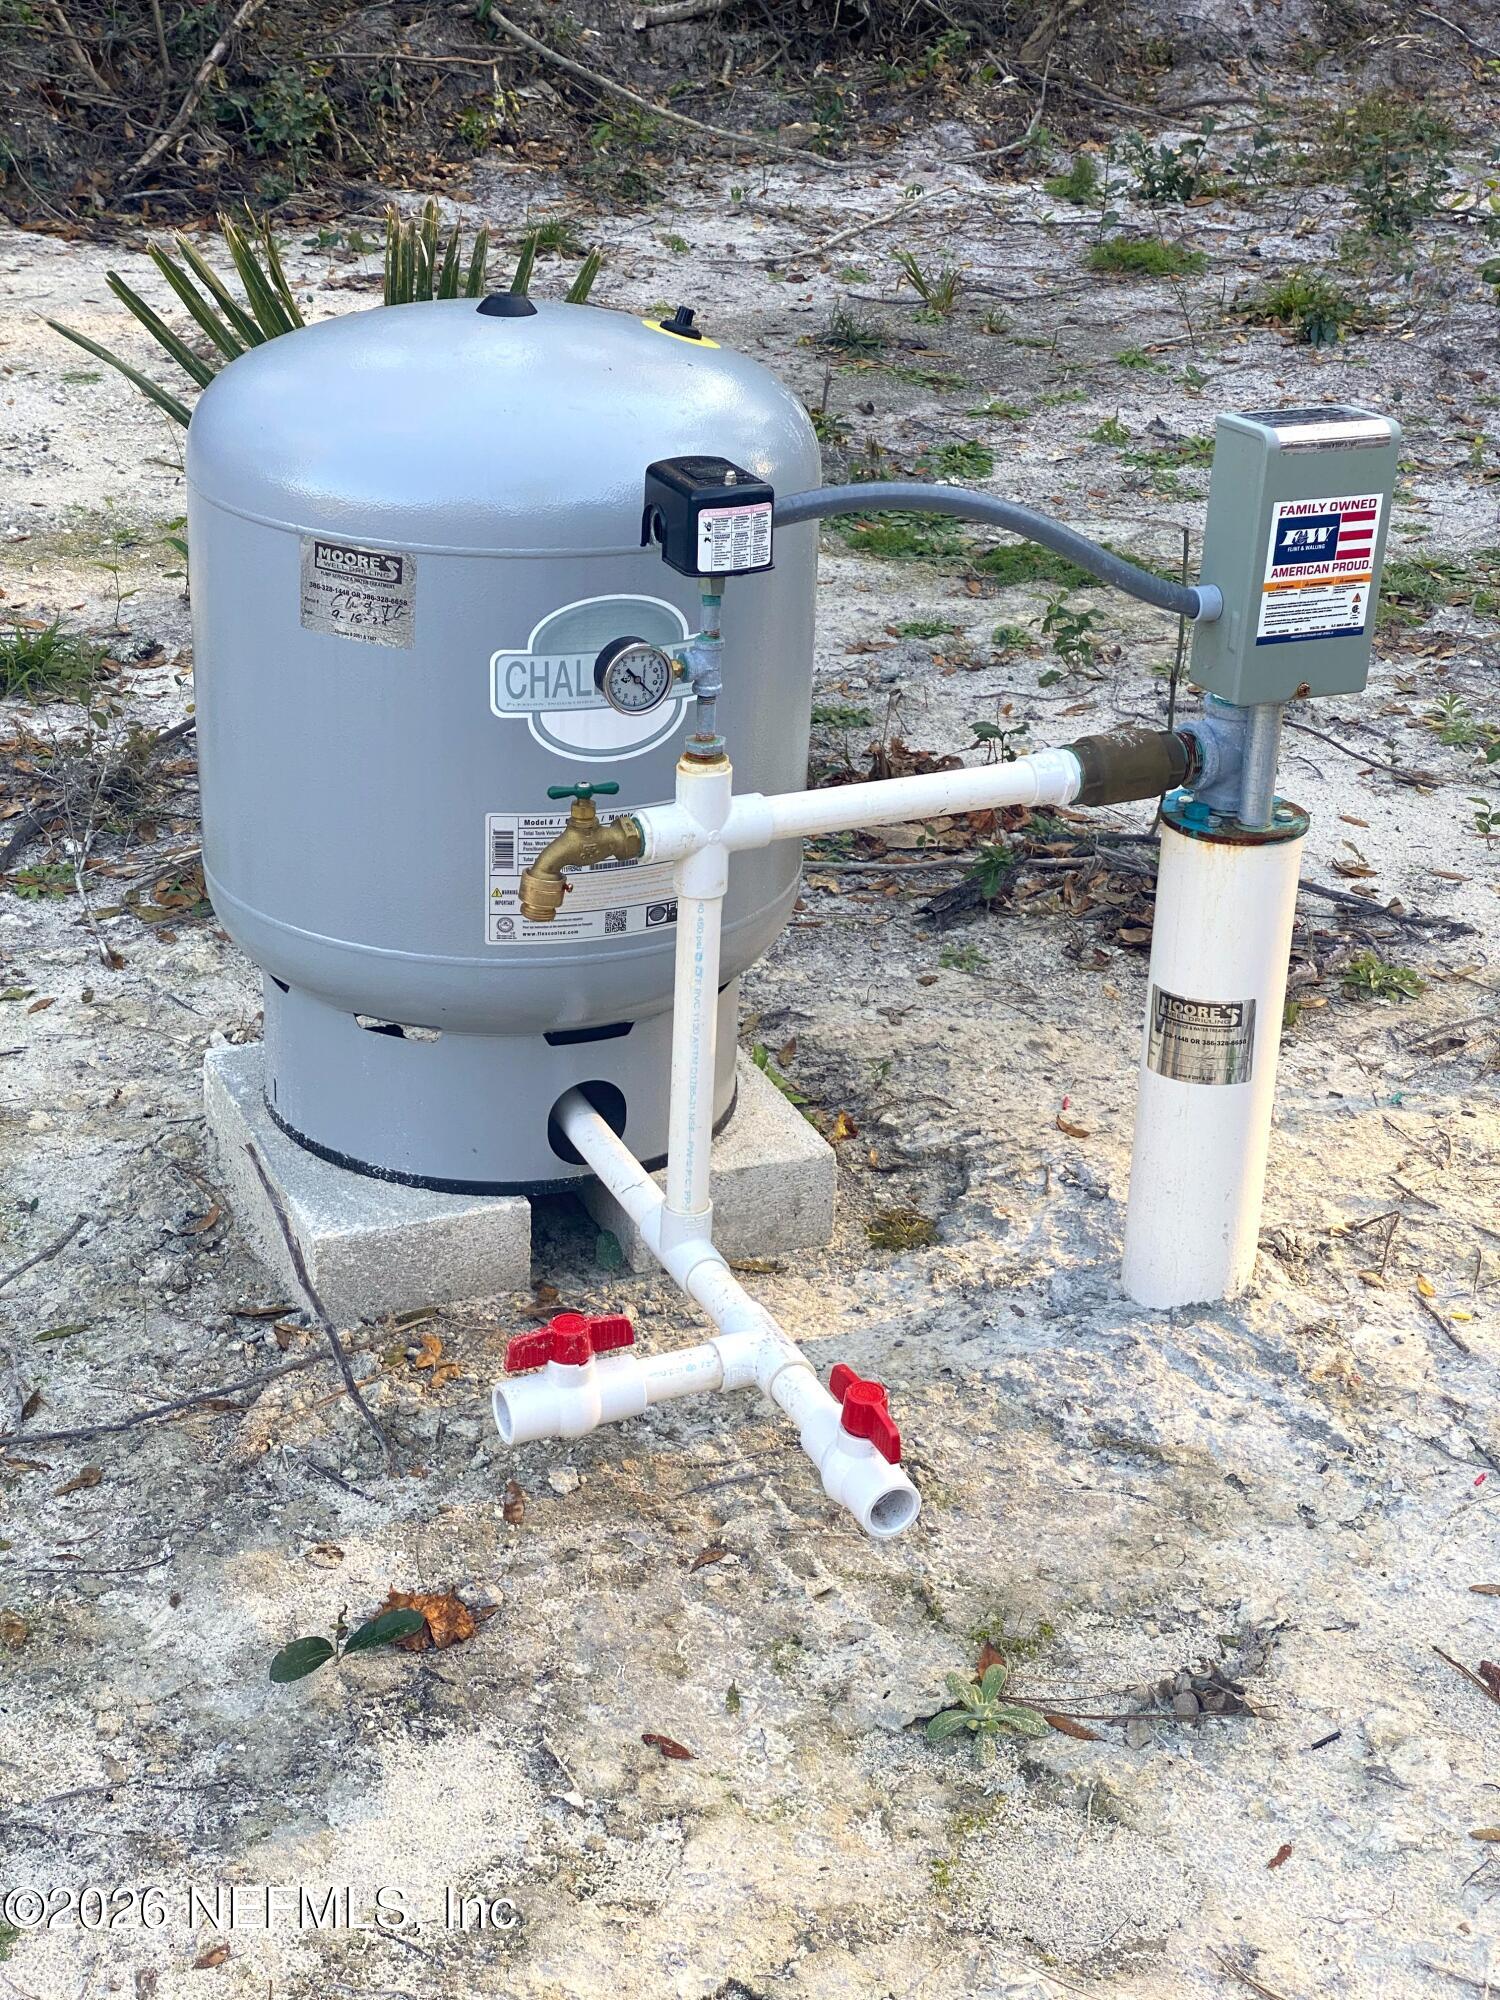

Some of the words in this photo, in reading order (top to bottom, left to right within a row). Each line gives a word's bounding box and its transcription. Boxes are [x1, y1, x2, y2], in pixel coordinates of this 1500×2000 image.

[1279, 503, 1326, 517] FAMILY
[1330, 498, 1377, 512] OWNED
[318, 546, 399, 580] MOORE'S
[324, 561, 347, 571] WELL
[1271, 564, 1329, 579] AMERICAN
[1331, 559, 1373, 573] PROUD.
[351, 591, 361, 599] OR
[505, 659, 602, 699] CHAL
